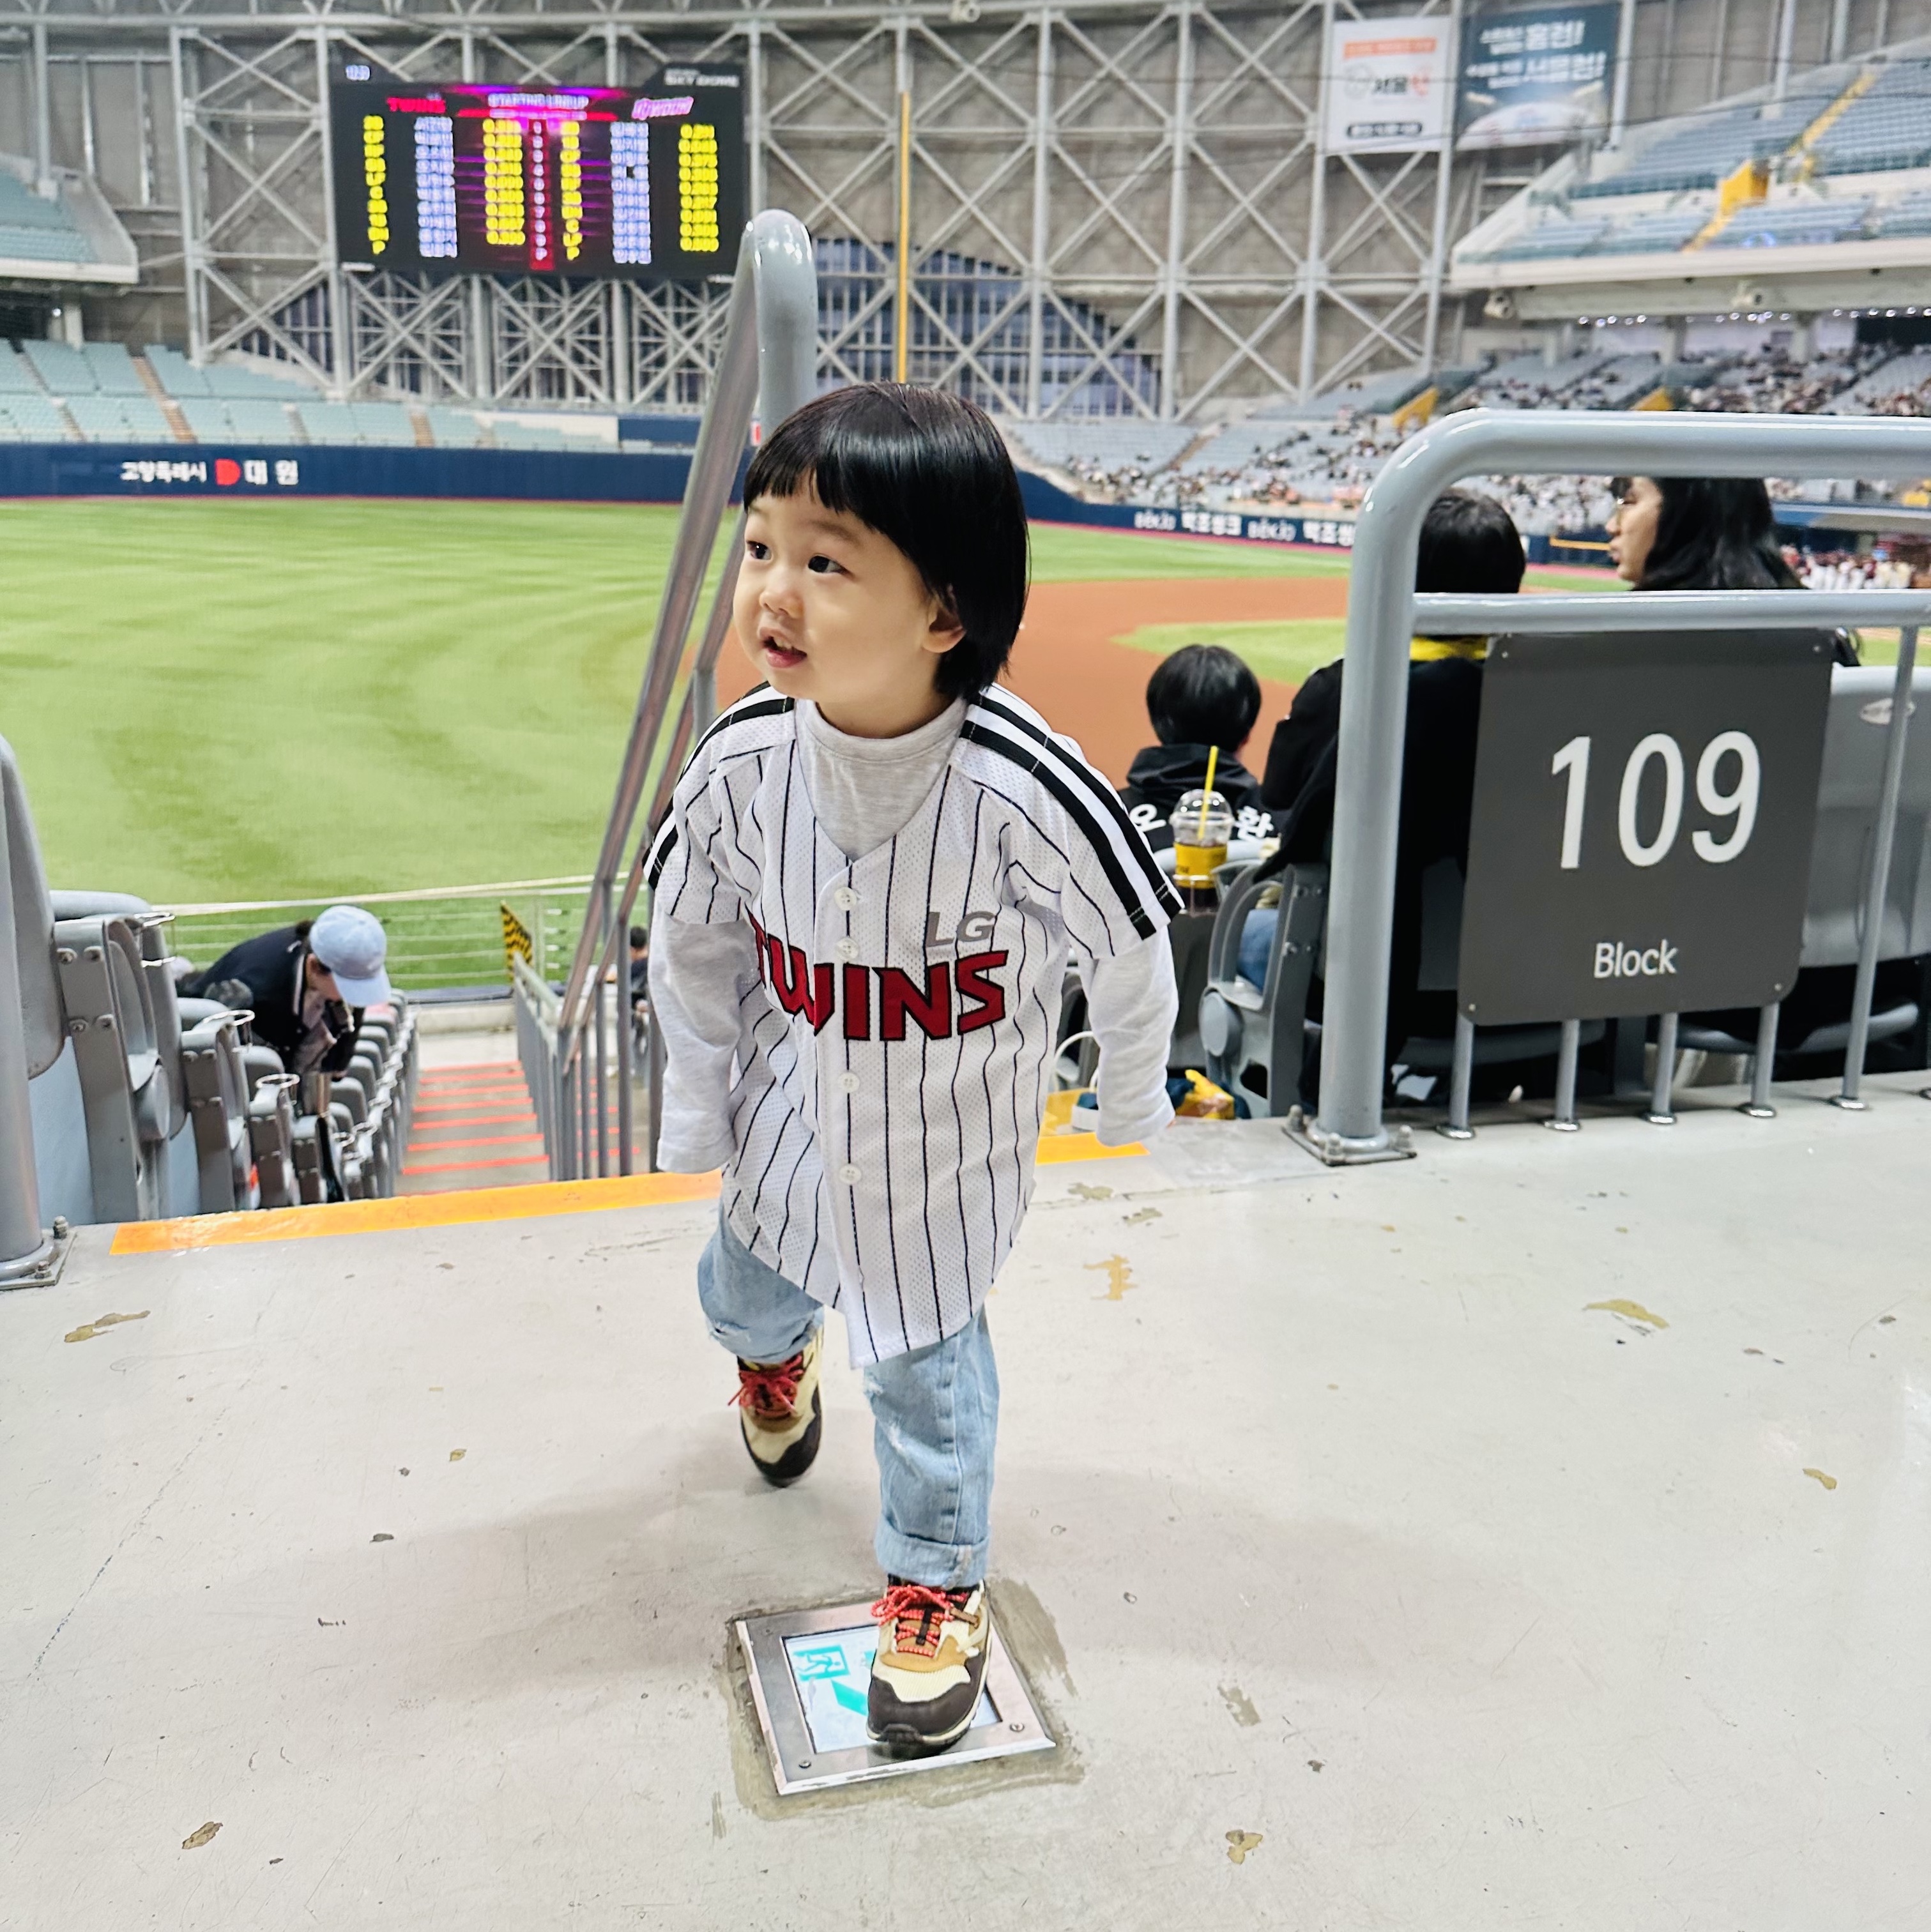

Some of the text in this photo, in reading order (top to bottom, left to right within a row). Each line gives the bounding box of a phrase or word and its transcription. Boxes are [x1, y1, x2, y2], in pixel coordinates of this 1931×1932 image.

[1552, 731, 1760, 869] 109
[925, 911, 996, 948] LG
[1594, 939, 1677, 979] Block
